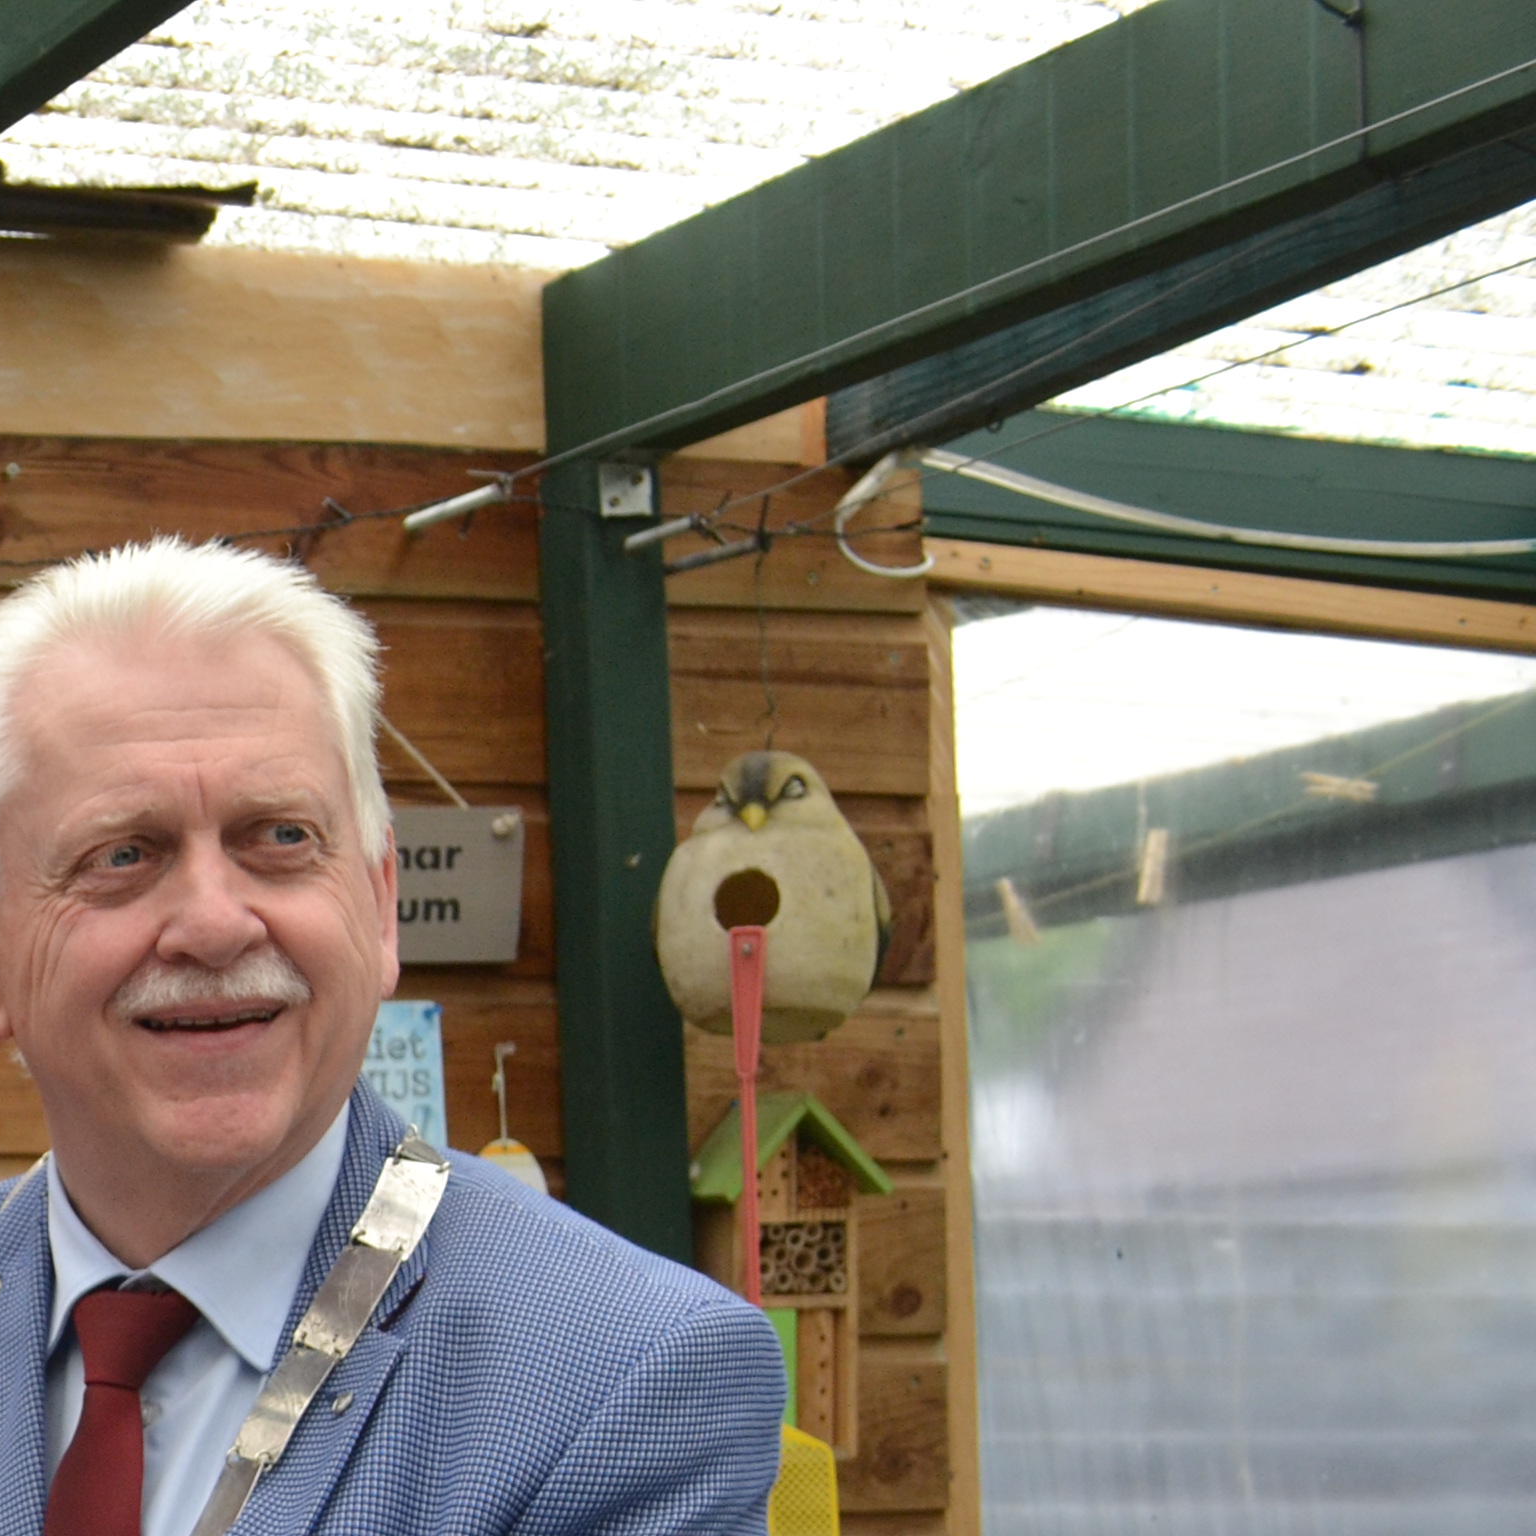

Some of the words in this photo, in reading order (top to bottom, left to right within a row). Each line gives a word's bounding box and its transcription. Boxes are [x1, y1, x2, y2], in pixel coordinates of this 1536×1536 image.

[397, 898, 460, 923] um
[366, 1026, 426, 1060] iet
[369, 1068, 431, 1100] IJS
